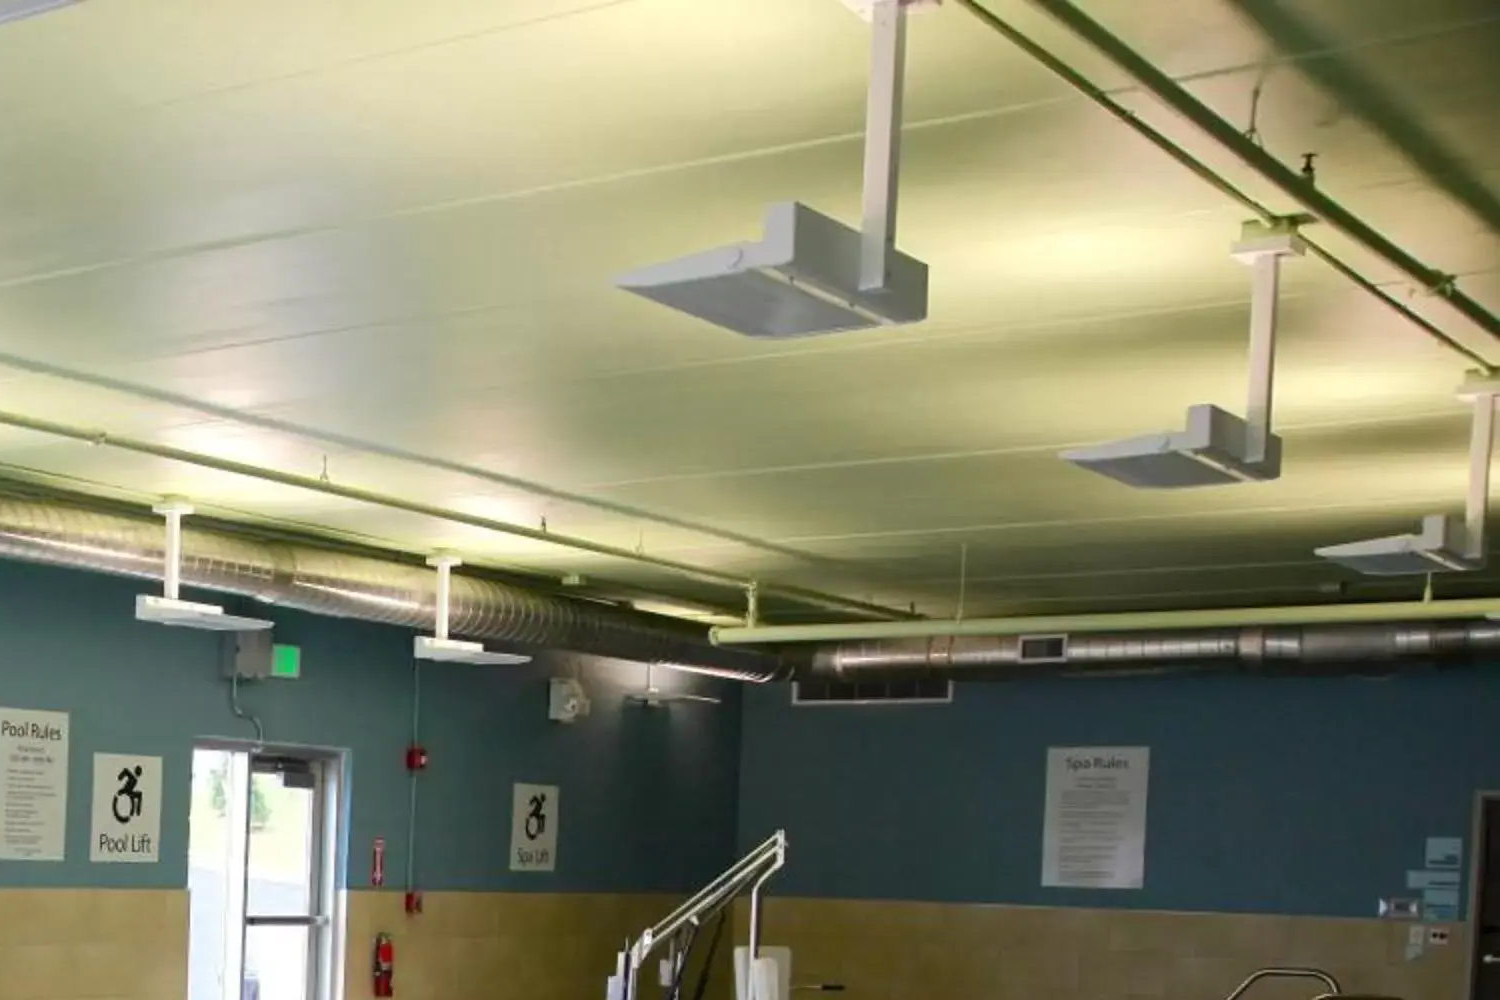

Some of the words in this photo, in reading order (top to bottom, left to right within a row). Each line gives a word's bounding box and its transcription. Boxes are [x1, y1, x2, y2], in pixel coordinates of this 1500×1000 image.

[1, 720, 28, 738] Pool
[31, 722, 62, 741] Rules
[99, 832, 128, 853] Pool
[131, 832, 151, 853] Lift
